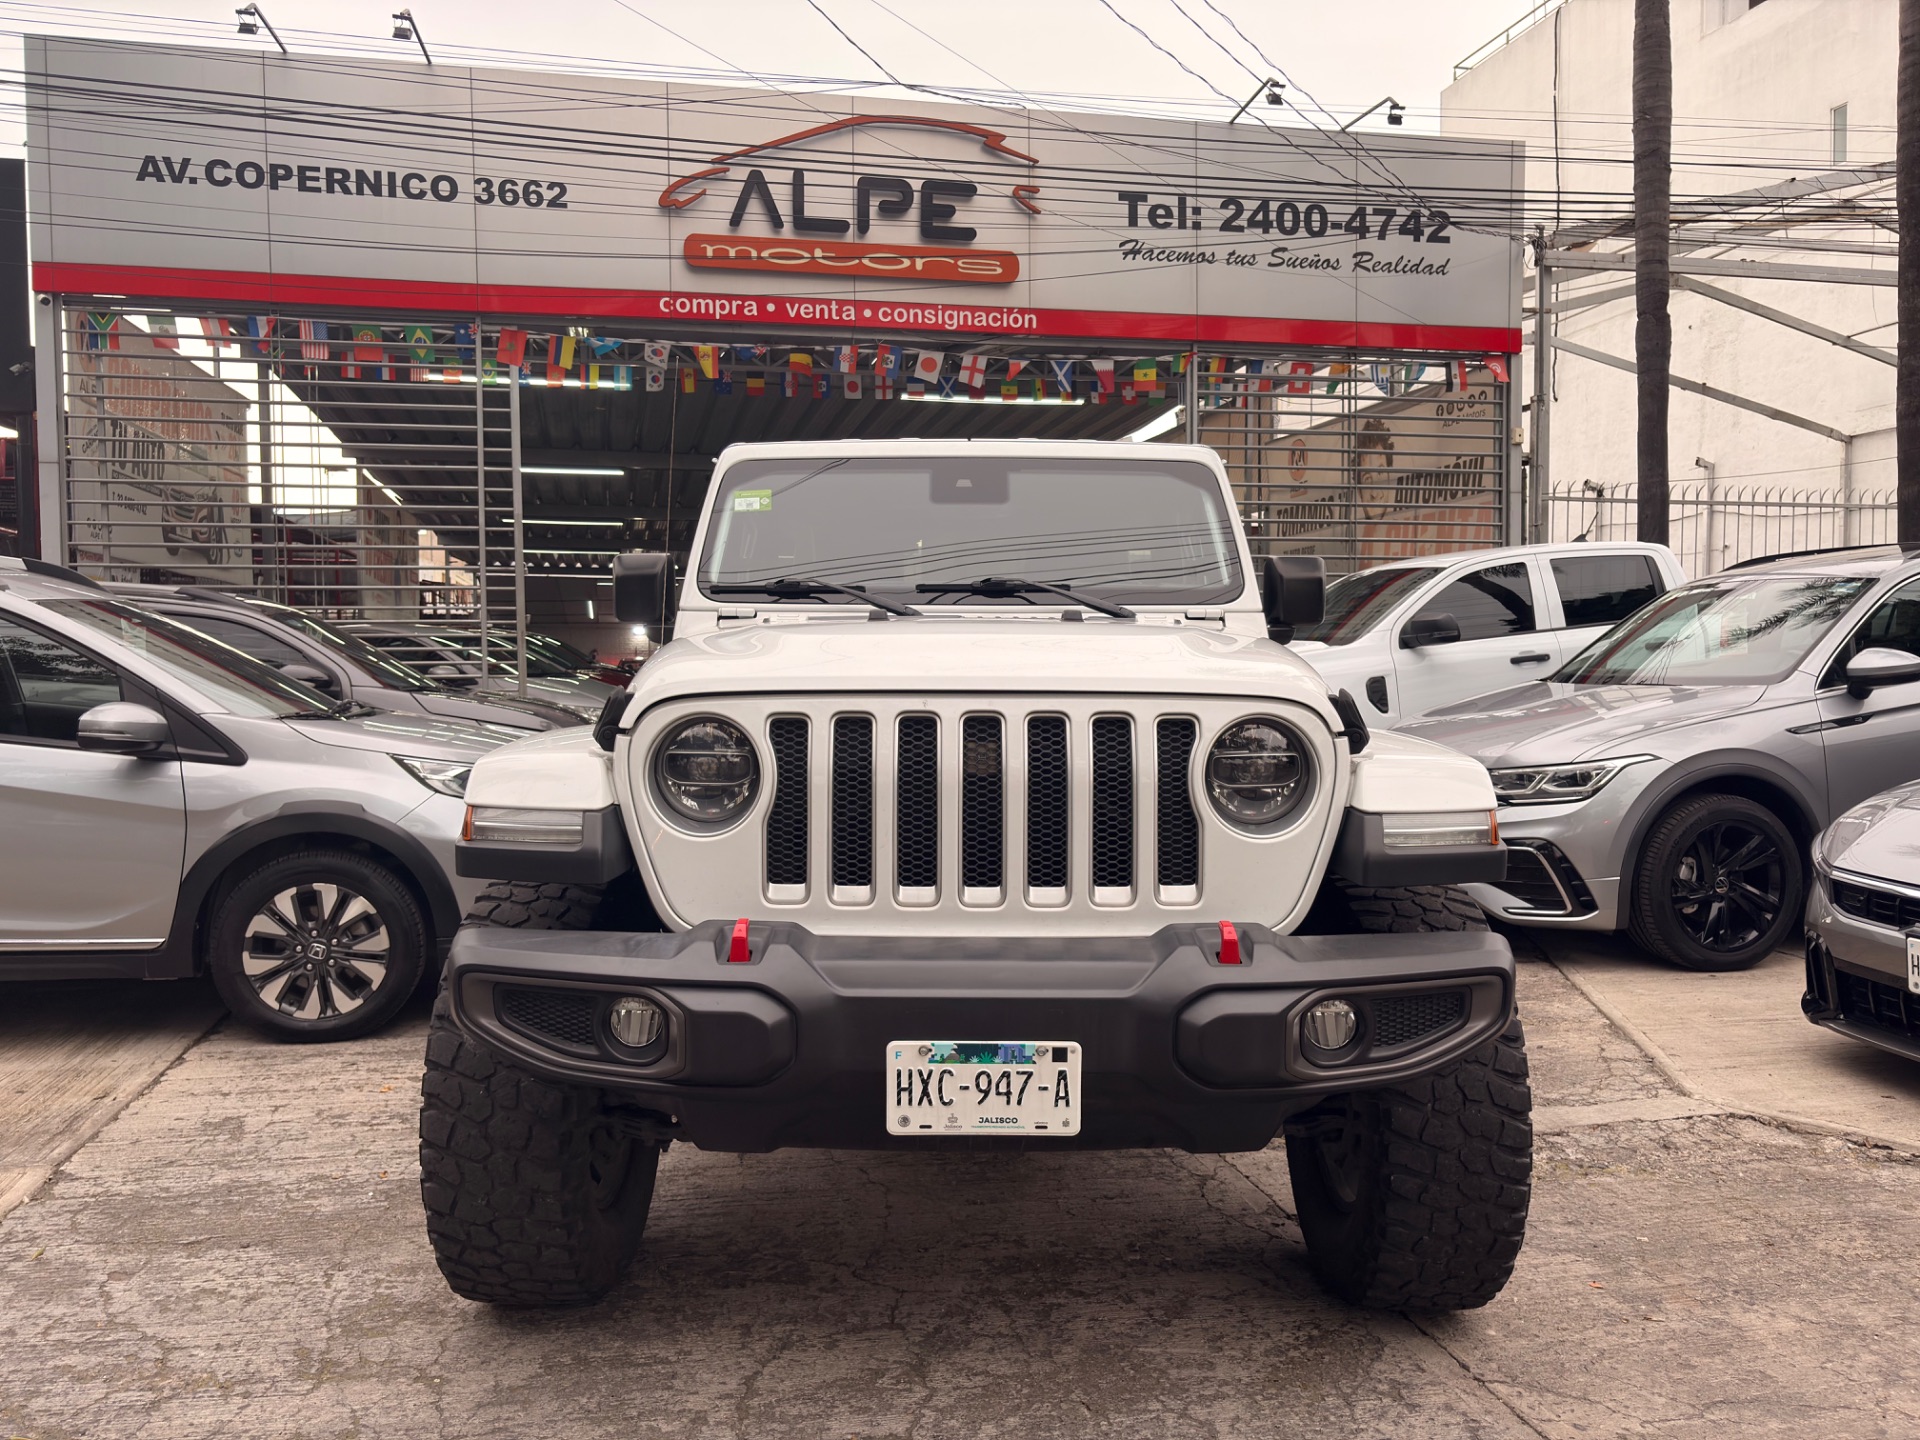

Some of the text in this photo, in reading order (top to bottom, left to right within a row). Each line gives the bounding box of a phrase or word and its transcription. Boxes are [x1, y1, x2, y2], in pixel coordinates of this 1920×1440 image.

[474, 178, 568, 208] 3662
[729, 169, 977, 241] ALPE
[1118, 192, 1451, 244] Tel: 2400-4742
[700, 244, 1003, 275] motors
[1119, 239, 1451, 276] Hacemos tus Sueños Realidad
[660, 297, 1037, 329] compra venta consignación
[896, 1068, 1070, 1108] HXC-947-A
[978, 1116, 1018, 1124] JALISCO
